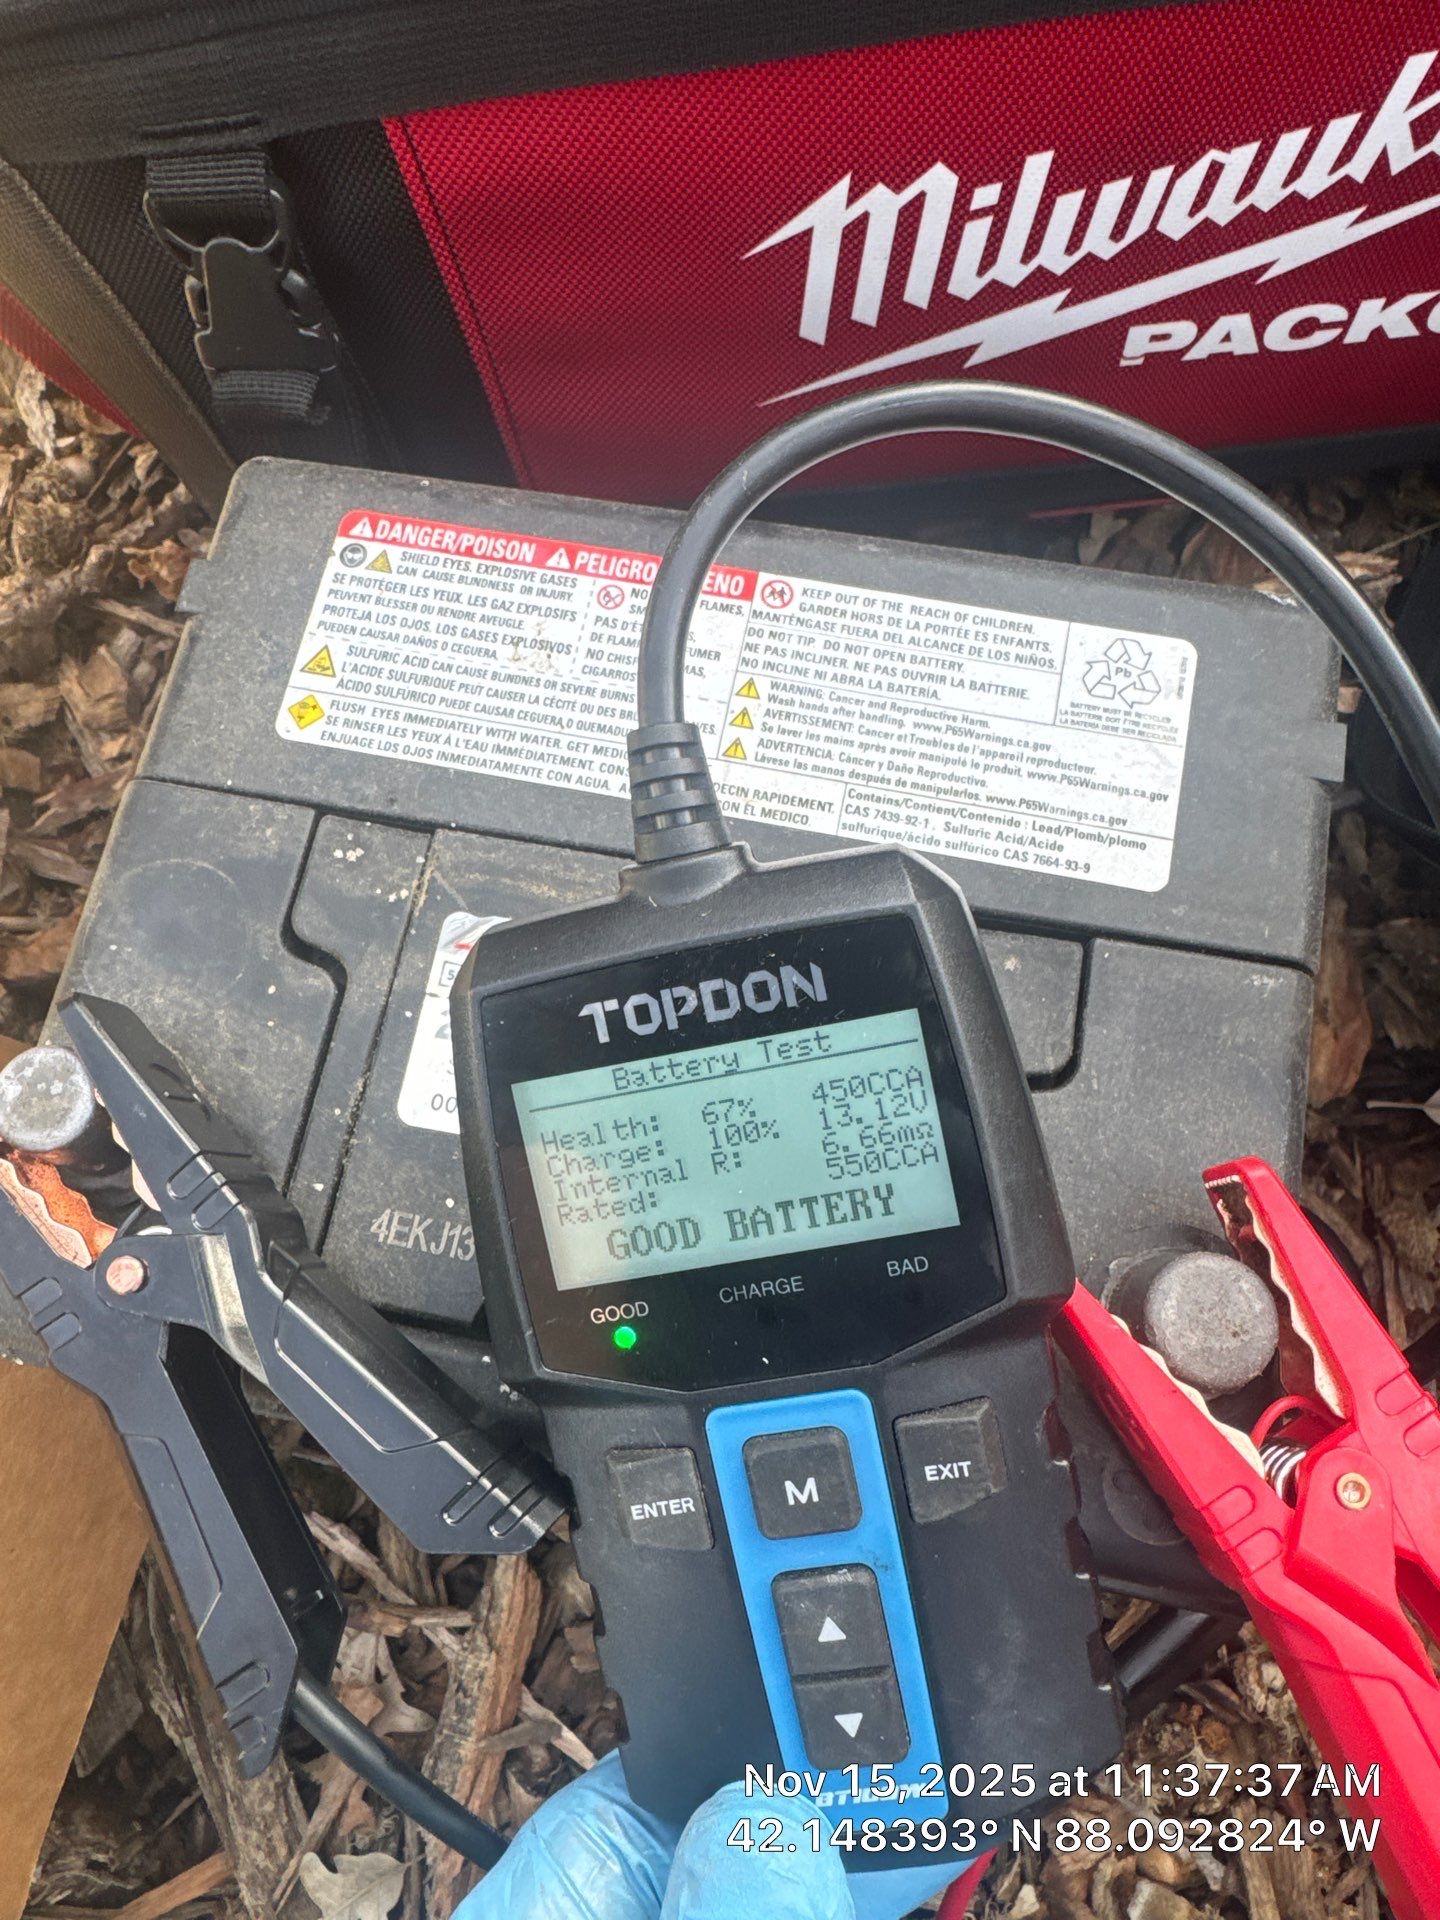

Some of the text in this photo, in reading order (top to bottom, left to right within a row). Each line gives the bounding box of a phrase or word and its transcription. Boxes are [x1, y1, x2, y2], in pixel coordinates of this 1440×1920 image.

[741, 51, 1440, 345] Milwauk
[1119, 288, 1440, 366] PACK
[374, 519, 534, 562] DANGER/POISON
[397, 565, 573, 601] CAN CAUSE BLINDNESS OR INJURY.
[400, 551, 578, 588] SHIELD EYES. EXPLOSIVE GASES
[327, 588, 477, 623] PEUVENT BLESSER RENDRE
[410, 585, 577, 622] LES LES GAZ EXPLOSIFS
[799, 602, 847, 619] GARDER
[851, 611, 883, 625] HORS
[802, 587, 1034, 634] KEEP OUT OF THE REACH OF CHILDREN.
[317, 620, 439, 649] PUEDEN CAUSAR DAÑOS
[322, 604, 572, 655] PROTEJA LOS OJOS. LOS GASES EXPLOSIVOS
[594, 615, 618, 629] PAS
[747, 627, 764, 638] DO
[768, 630, 793, 643] NOT
[823, 640, 840, 651] DO
[844, 643, 870, 656] NOT
[873, 648, 906, 663] OPEN
[840, 624, 1011, 661] FUERA DEL ALCANCE DE LOS
[346, 645, 638, 703] SULFURIC ACID CAN CAUSE OR SEVERE BURNS
[741, 657, 882, 691] NO INCLINE NI ABRA LA
[744, 642, 965, 689] NE PAS NE PAS OUVRIR LA
[1115, 667, 1132, 678] Pb
[386, 669, 456, 691] SULFURIQUE
[457, 683, 485, 696] PEUT
[486, 687, 526, 703] CAUSER
[597, 706, 617, 718] DES
[439, 696, 515, 718] PUEDE CAUSAR
[768, 693, 856, 718] Wash hands after
[829, 691, 991, 728] Cancer and Reproductive Harm.
[330, 700, 590, 753] FLUSH EYES IMMEDIATELY WITH GET
[342, 718, 442, 744] RINSER LES YEUX
[777, 725, 916, 758] laver les mains avoir
[858, 725, 955, 751] Cancer Troubles
[320, 730, 572, 783] ENJUAGE LOS OJOS INMEDIATAMENTE CON
[793, 758, 845, 777] las manos
[752, 789, 834, 813] RAPIDEMENT.
[845, 804, 991, 839] CAS Sulfuric
[1003, 848, 1090, 873] CAS 7664-93-9
[578, 962, 828, 1043] TOPDON
[612, 1031, 833, 1092] Battery Test
[540, 1065, 925, 1155] Health: 67% 450CCA
[546, 1089, 929, 1180] Charge: 100% 13.12V
[554, 1160, 689, 1203] Internal
[711, 1150, 743, 1176] R:
[558, 1142, 940, 1227] Rated: 550CCA
[605, 1183, 896, 1262] GOOD BATTERY
[886, 1255, 929, 1278] BAD
[718, 1275, 806, 1304] CHARGE
[590, 1301, 650, 1324] GOOD
[924, 1460, 972, 1482] EXIT
[630, 1496, 696, 1521] ENTER
[784, 1476, 820, 1506] M
